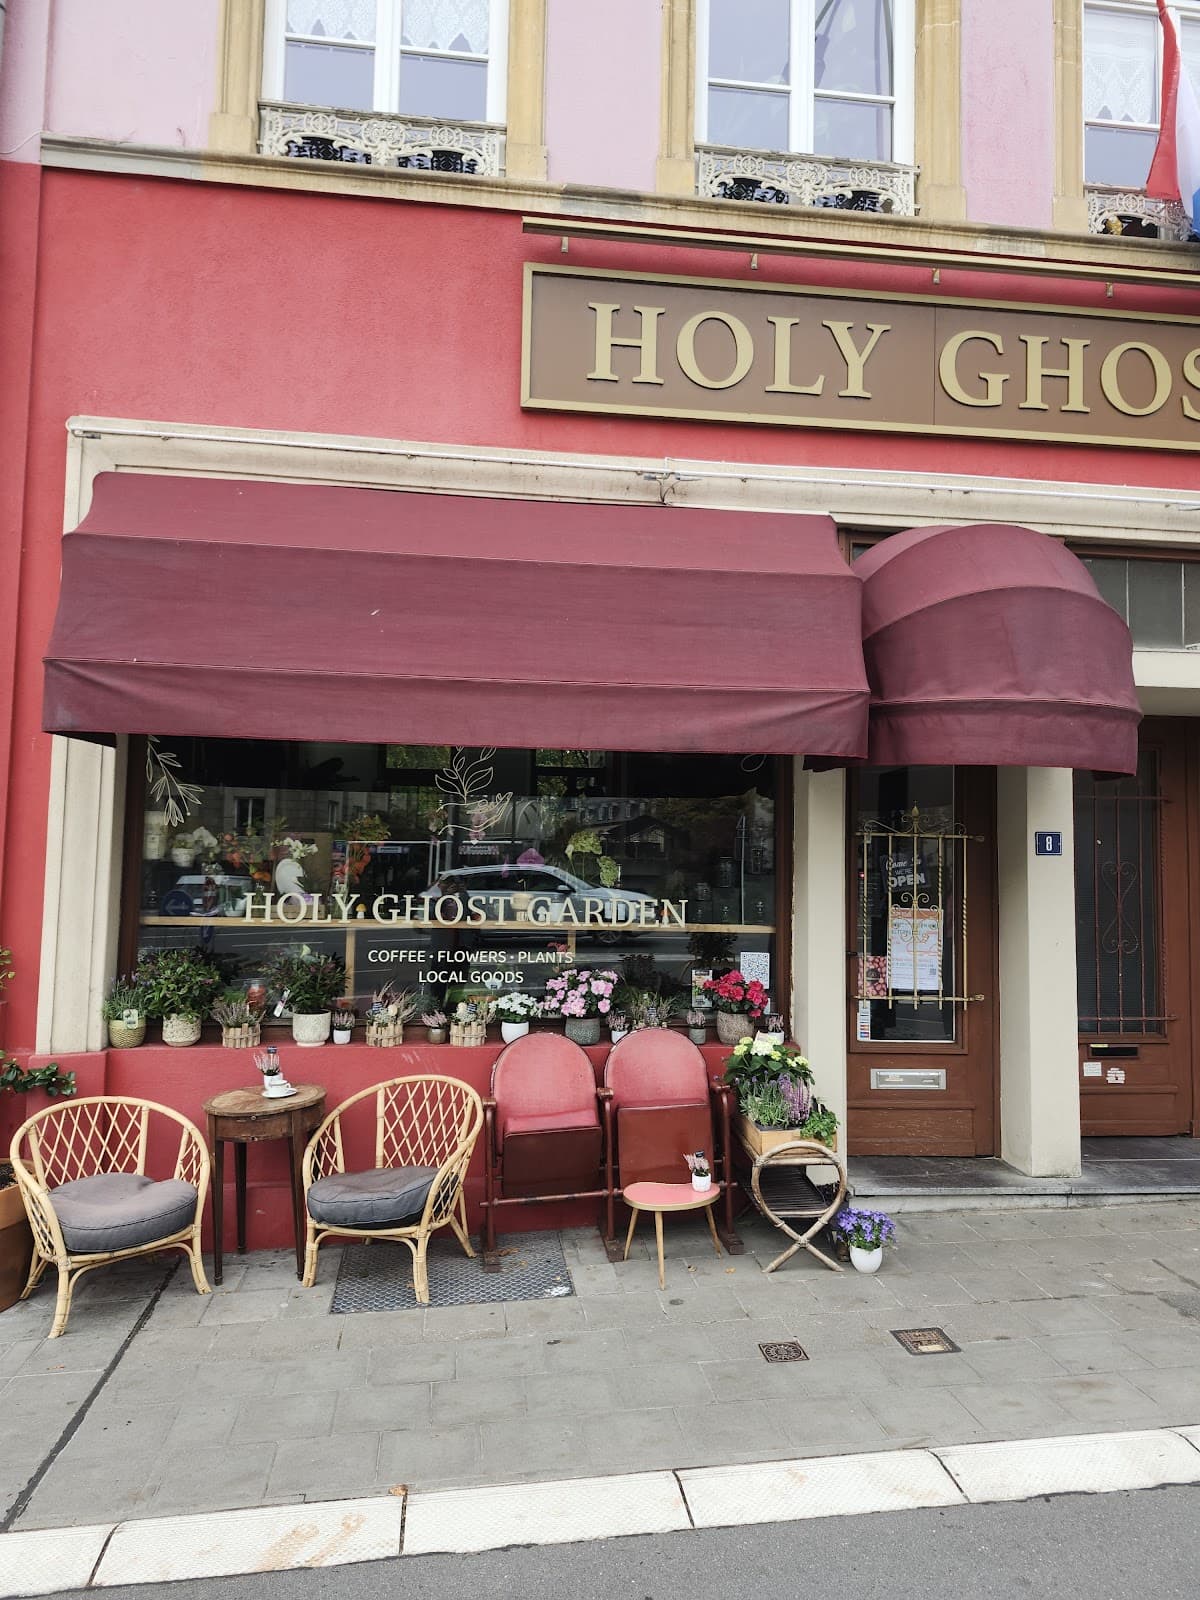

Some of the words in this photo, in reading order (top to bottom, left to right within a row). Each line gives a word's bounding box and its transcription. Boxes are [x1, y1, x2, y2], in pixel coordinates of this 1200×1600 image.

[586, 301, 892, 399] HOLY
[1045, 835, 1053, 851] 8
[888, 872, 926, 888] OPEN
[241, 892, 361, 924] HOLY
[372, 893, 514, 926] GHOST
[526, 896, 689, 929] GARDEN
[367, 949, 426, 963] COFFEE
[437, 950, 507, 964] FLOWERS
[518, 951, 574, 964] PLANTS
[418, 970, 467, 983] LOCAL
[470, 971, 524, 984] GOODS
